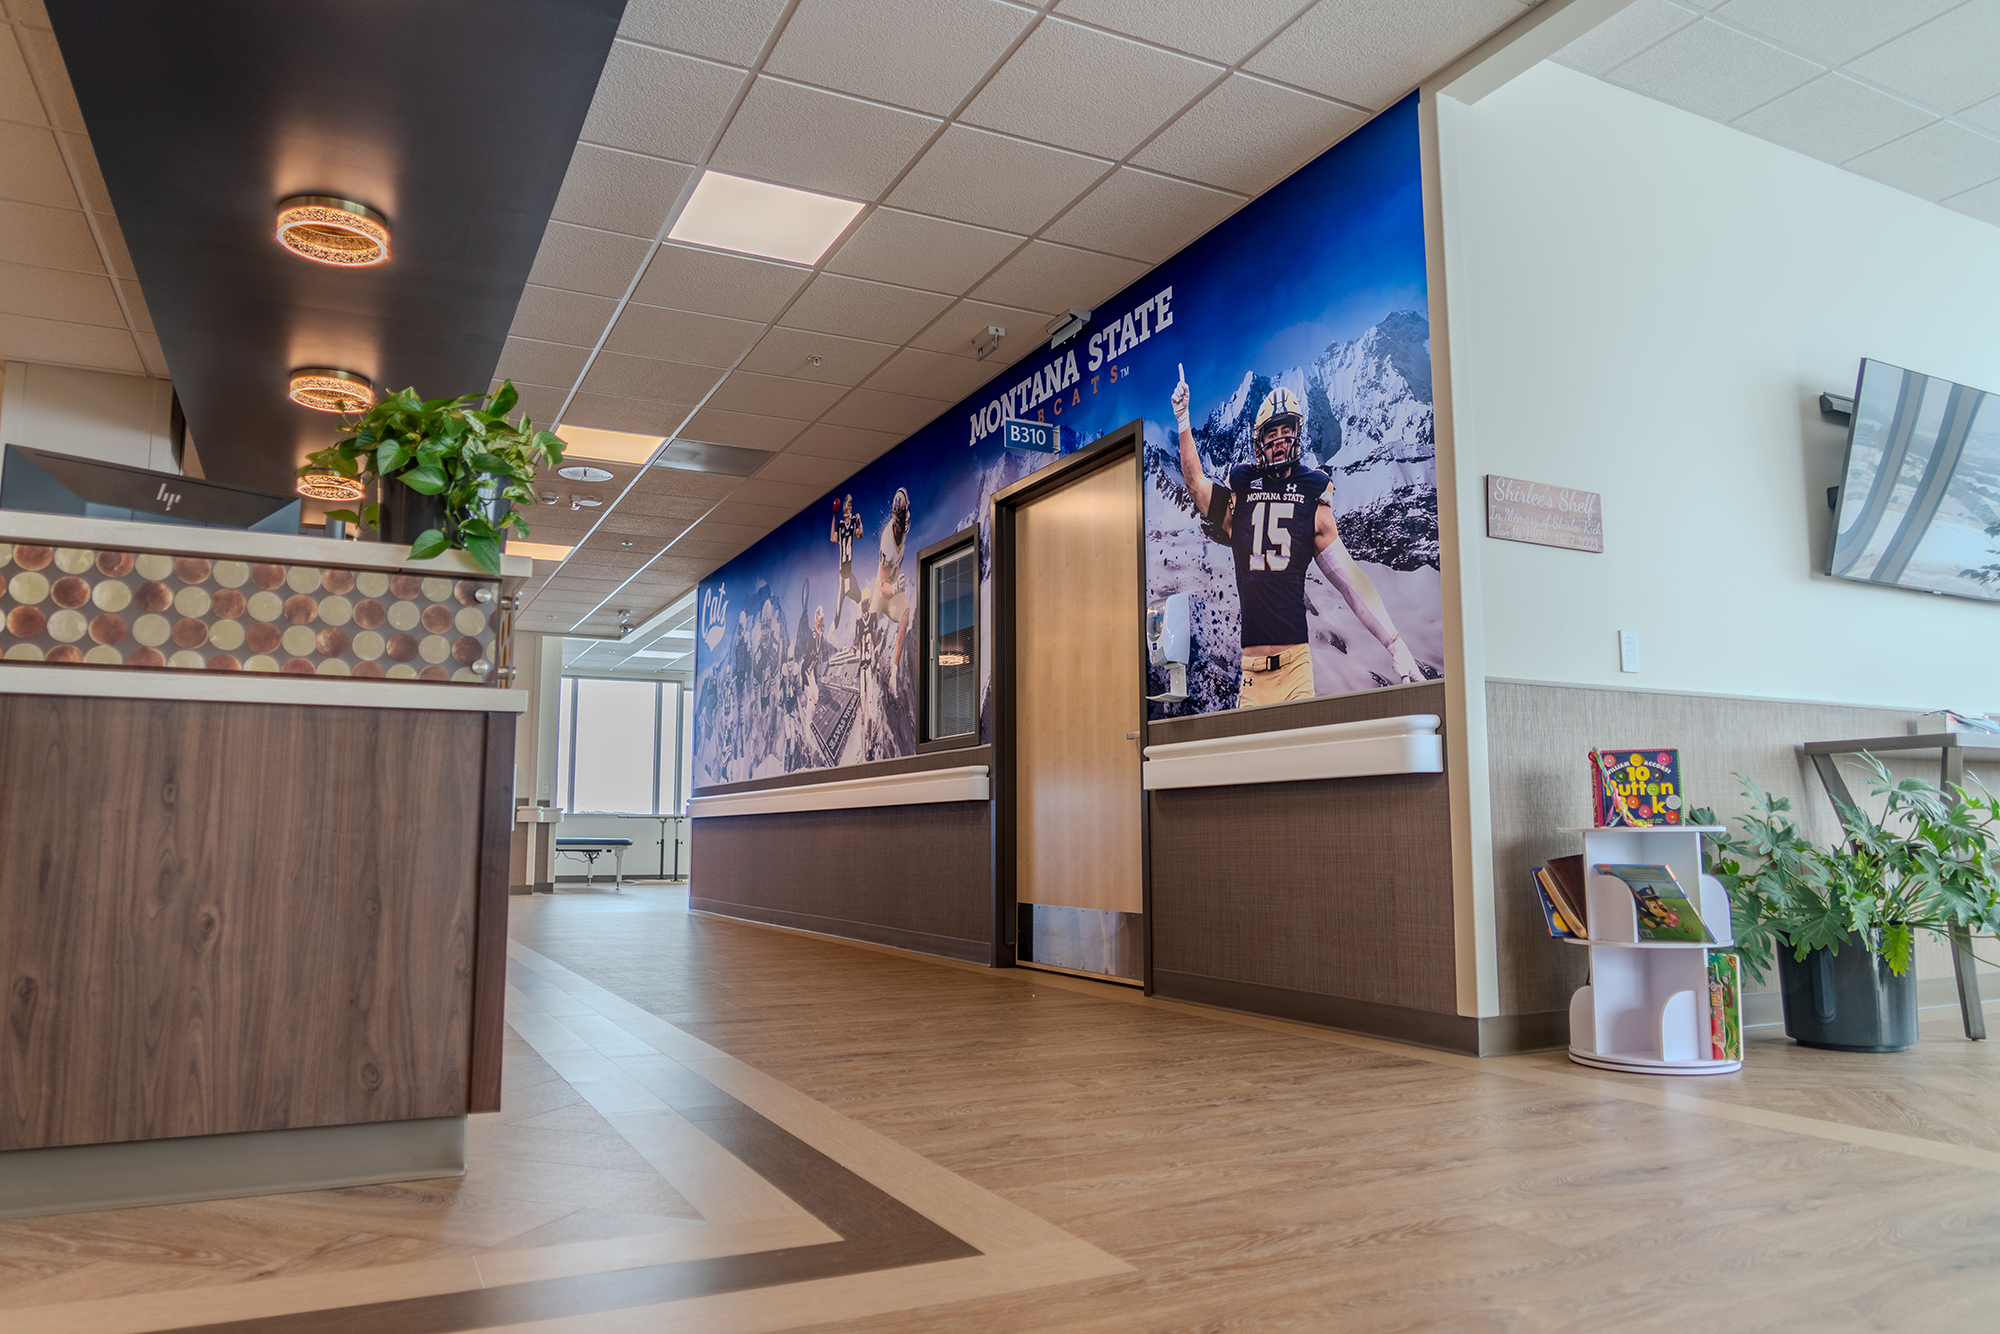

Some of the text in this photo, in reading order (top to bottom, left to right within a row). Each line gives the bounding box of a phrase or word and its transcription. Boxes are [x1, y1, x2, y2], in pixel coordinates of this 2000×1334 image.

[969, 285, 1173, 447] MONTANA STATE
[1023, 365, 1118, 424] BCATS
[1010, 424, 1047, 446] B310
[156, 483, 181, 511] hp
[1246, 491, 1305, 504] MONTANA STATE
[1493, 477, 1597, 521] Shirlee's Shelf
[1489, 504, 1503, 520] In
[1504, 507, 1540, 530] Memory
[1541, 514, 1551, 532] of
[1552, 515, 1582, 533] Shirlee
[842, 534, 853, 563] 14
[1249, 501, 1295, 572] 15
[1494, 523, 1510, 537] Jan
[1577, 535, 1599, 551] 2023
[701, 582, 729, 641] Cats
[861, 632, 871, 661] 13
[1626, 766, 1650, 782] 10
